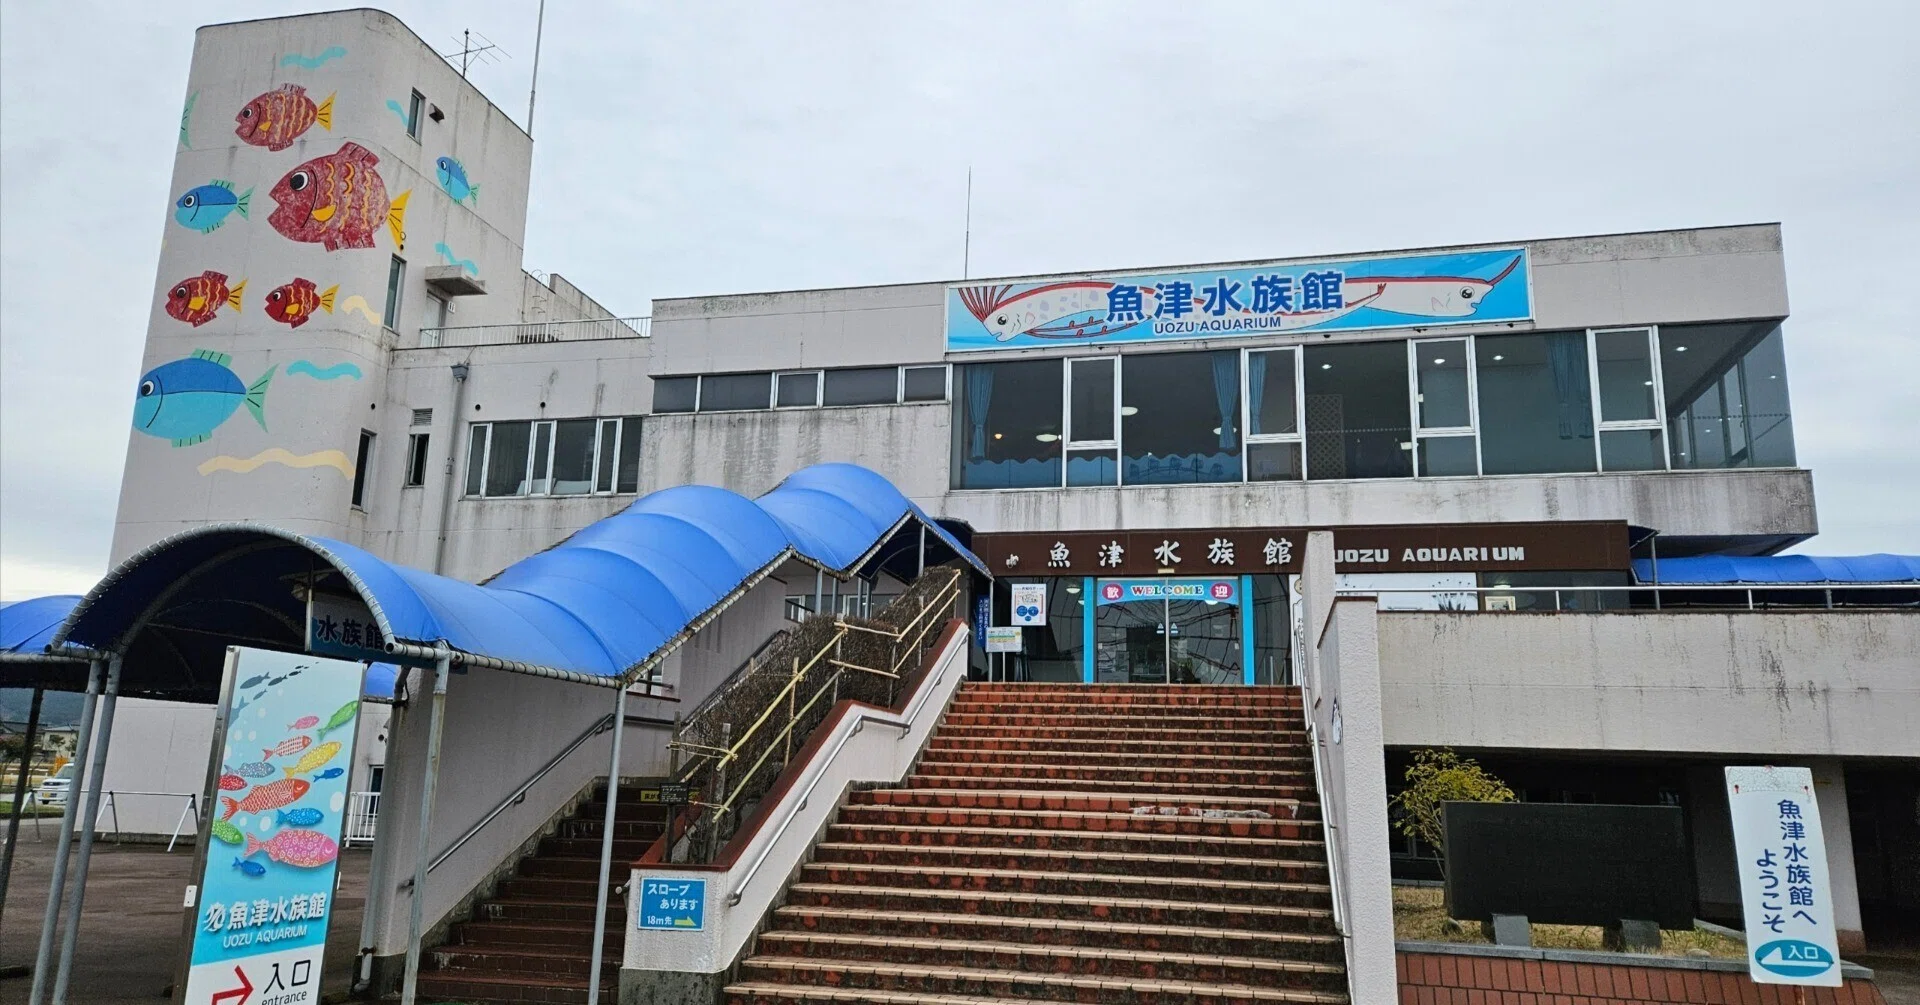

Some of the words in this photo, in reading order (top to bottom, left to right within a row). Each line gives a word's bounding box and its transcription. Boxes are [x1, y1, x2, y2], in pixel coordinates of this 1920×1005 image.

[1106, 270, 1343, 322] 魚津水族館
[1154, 322, 1195, 334] UOZU
[1199, 316, 1282, 331] AQUARIUM
[1047, 537, 1293, 568] 魚津水族館
[1402, 547, 1525, 562] AQUARIUM
[1106, 586, 1119, 599] 歓
[1130, 585, 1205, 597] WELCOME
[1215, 585, 1228, 598] 迎
[317, 614, 385, 650] 水族館
[1777, 798, 1817, 926] 魚津水族館へ
[647, 883, 691, 896] スロープ
[1756, 848, 1786, 934] ようこそ
[227, 891, 327, 930] 魚津水族館
[659, 899, 699, 910] あります
[647, 916, 672, 926] 18m先
[223, 932, 253, 949] UOZU
[255, 925, 308, 943] AQUARIUM
[1788, 945, 1819, 960] 入口
[263, 959, 311, 995] 入口
[261, 990, 308, 1005] entrance
